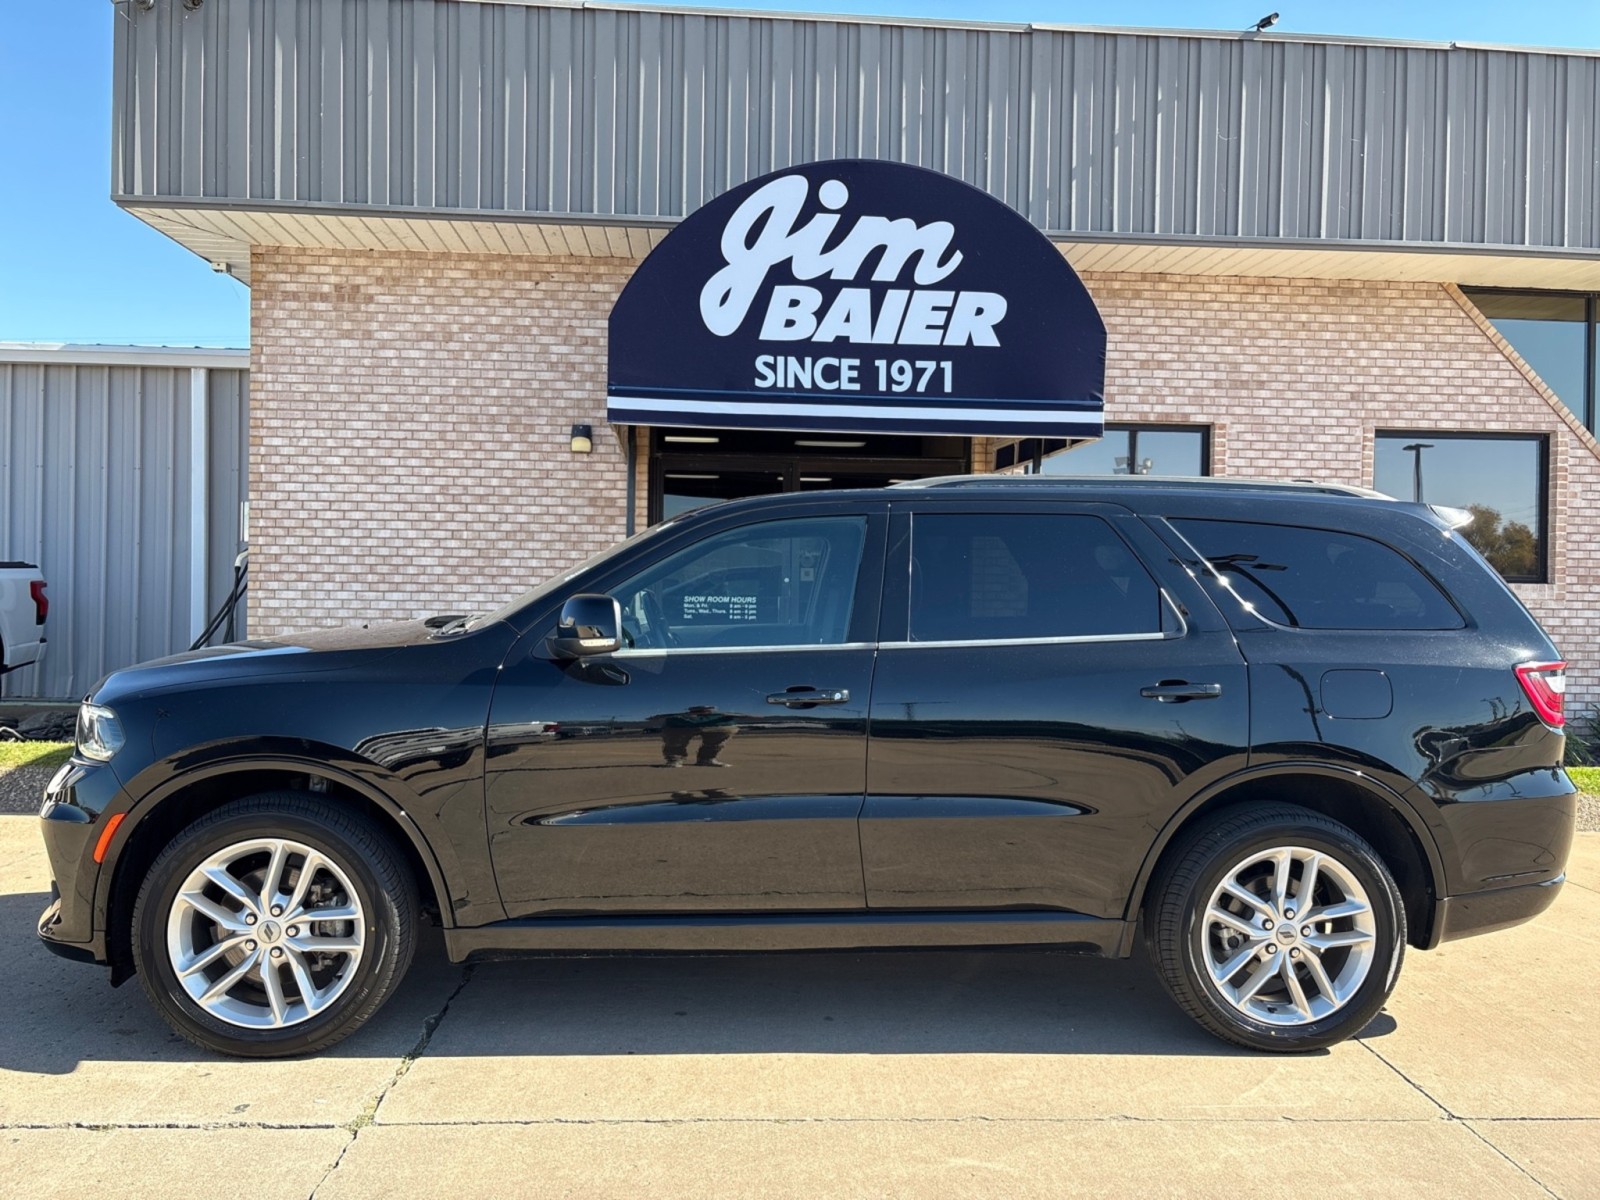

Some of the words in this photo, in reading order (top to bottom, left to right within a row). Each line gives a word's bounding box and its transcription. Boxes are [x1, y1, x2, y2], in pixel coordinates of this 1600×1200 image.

[700, 174, 963, 337] Jim
[758, 285, 1008, 347] BAIER
[754, 355, 860, 390] SINCE
[874, 359, 952, 393] 1971
[684, 595, 706, 603] SHOW
[731, 596, 757, 604] HOURS
